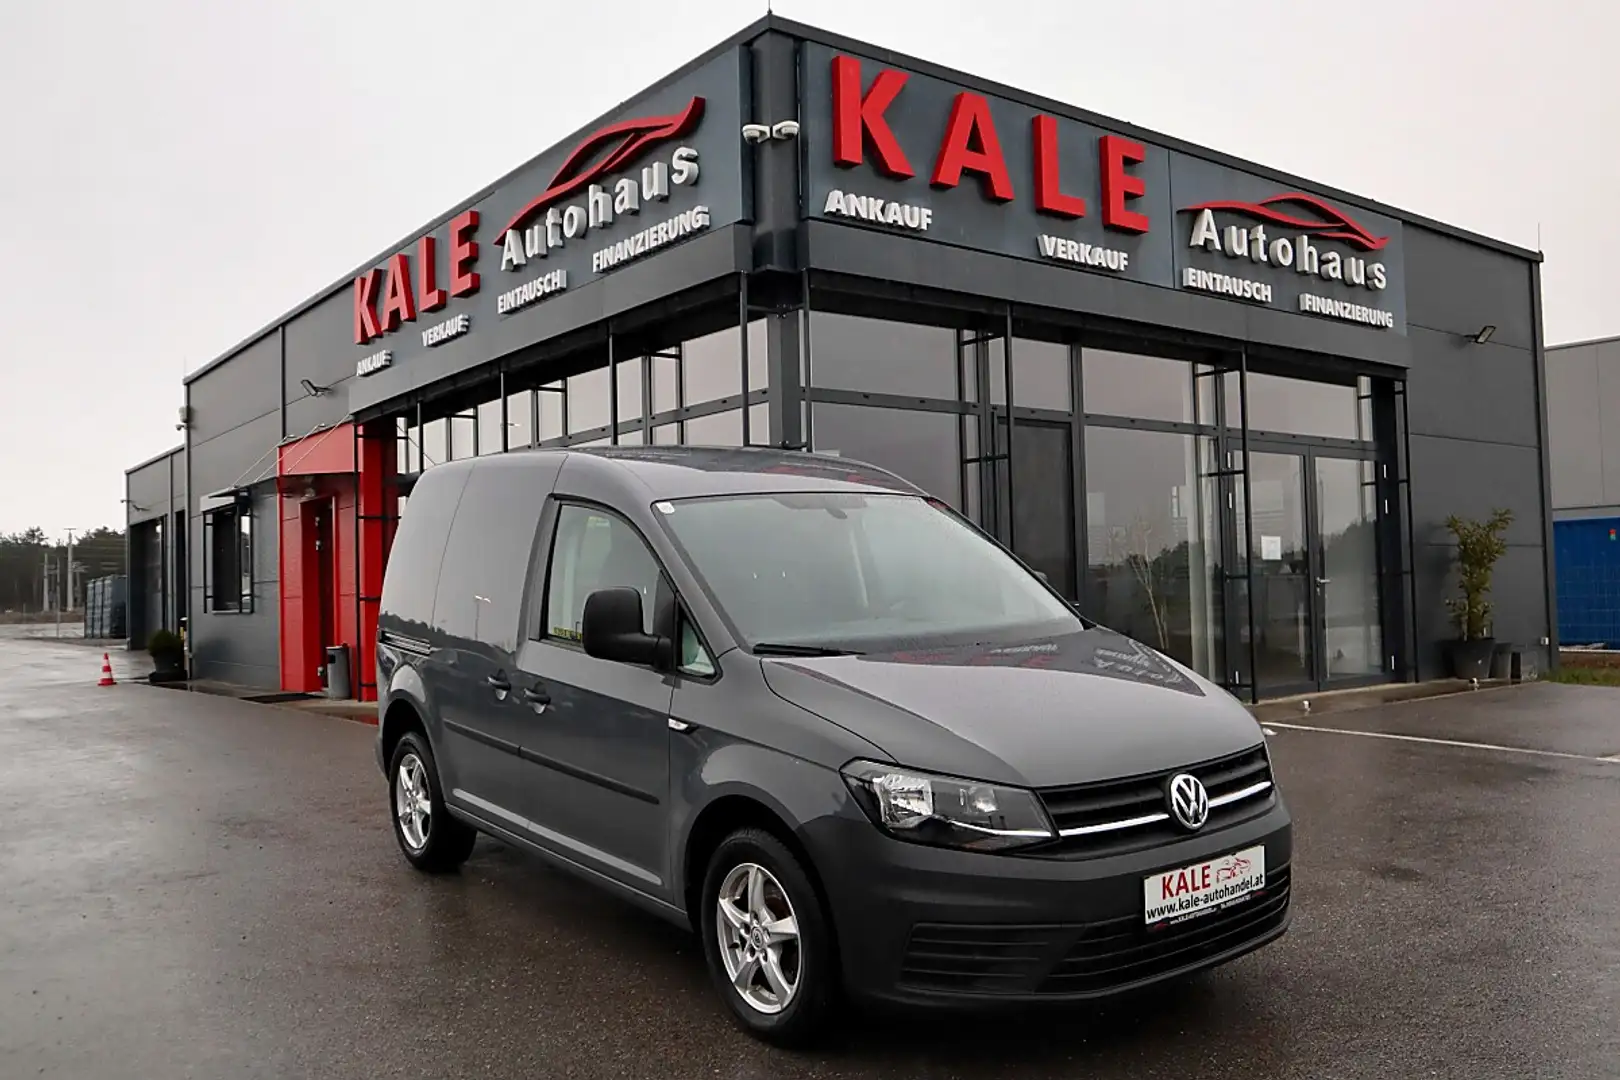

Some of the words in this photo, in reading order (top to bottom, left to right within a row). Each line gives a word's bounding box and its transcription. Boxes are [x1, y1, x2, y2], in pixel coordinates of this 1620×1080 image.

[832, 54, 1149, 235] KALE
[501, 145, 699, 271] Autohaus
[823, 189, 932, 231] ANKAUF
[592, 205, 710, 273] FINANZIERUNG
[1036, 233, 1129, 272] VERKAUF
[1190, 208, 1387, 290] Autohaus
[354, 210, 480, 345] KALE
[497, 269, 567, 314] EINTAUSCH
[1182, 267, 1272, 302] EINTAUSCH
[422, 314, 470, 347] VERKAUF
[1299, 293, 1394, 328] FINANZIERUNG
[356, 350, 393, 377] ANKAUF
[1146, 873, 1264, 920] www.kale-autohandel.at
[1162, 865, 1211, 900] KALE
